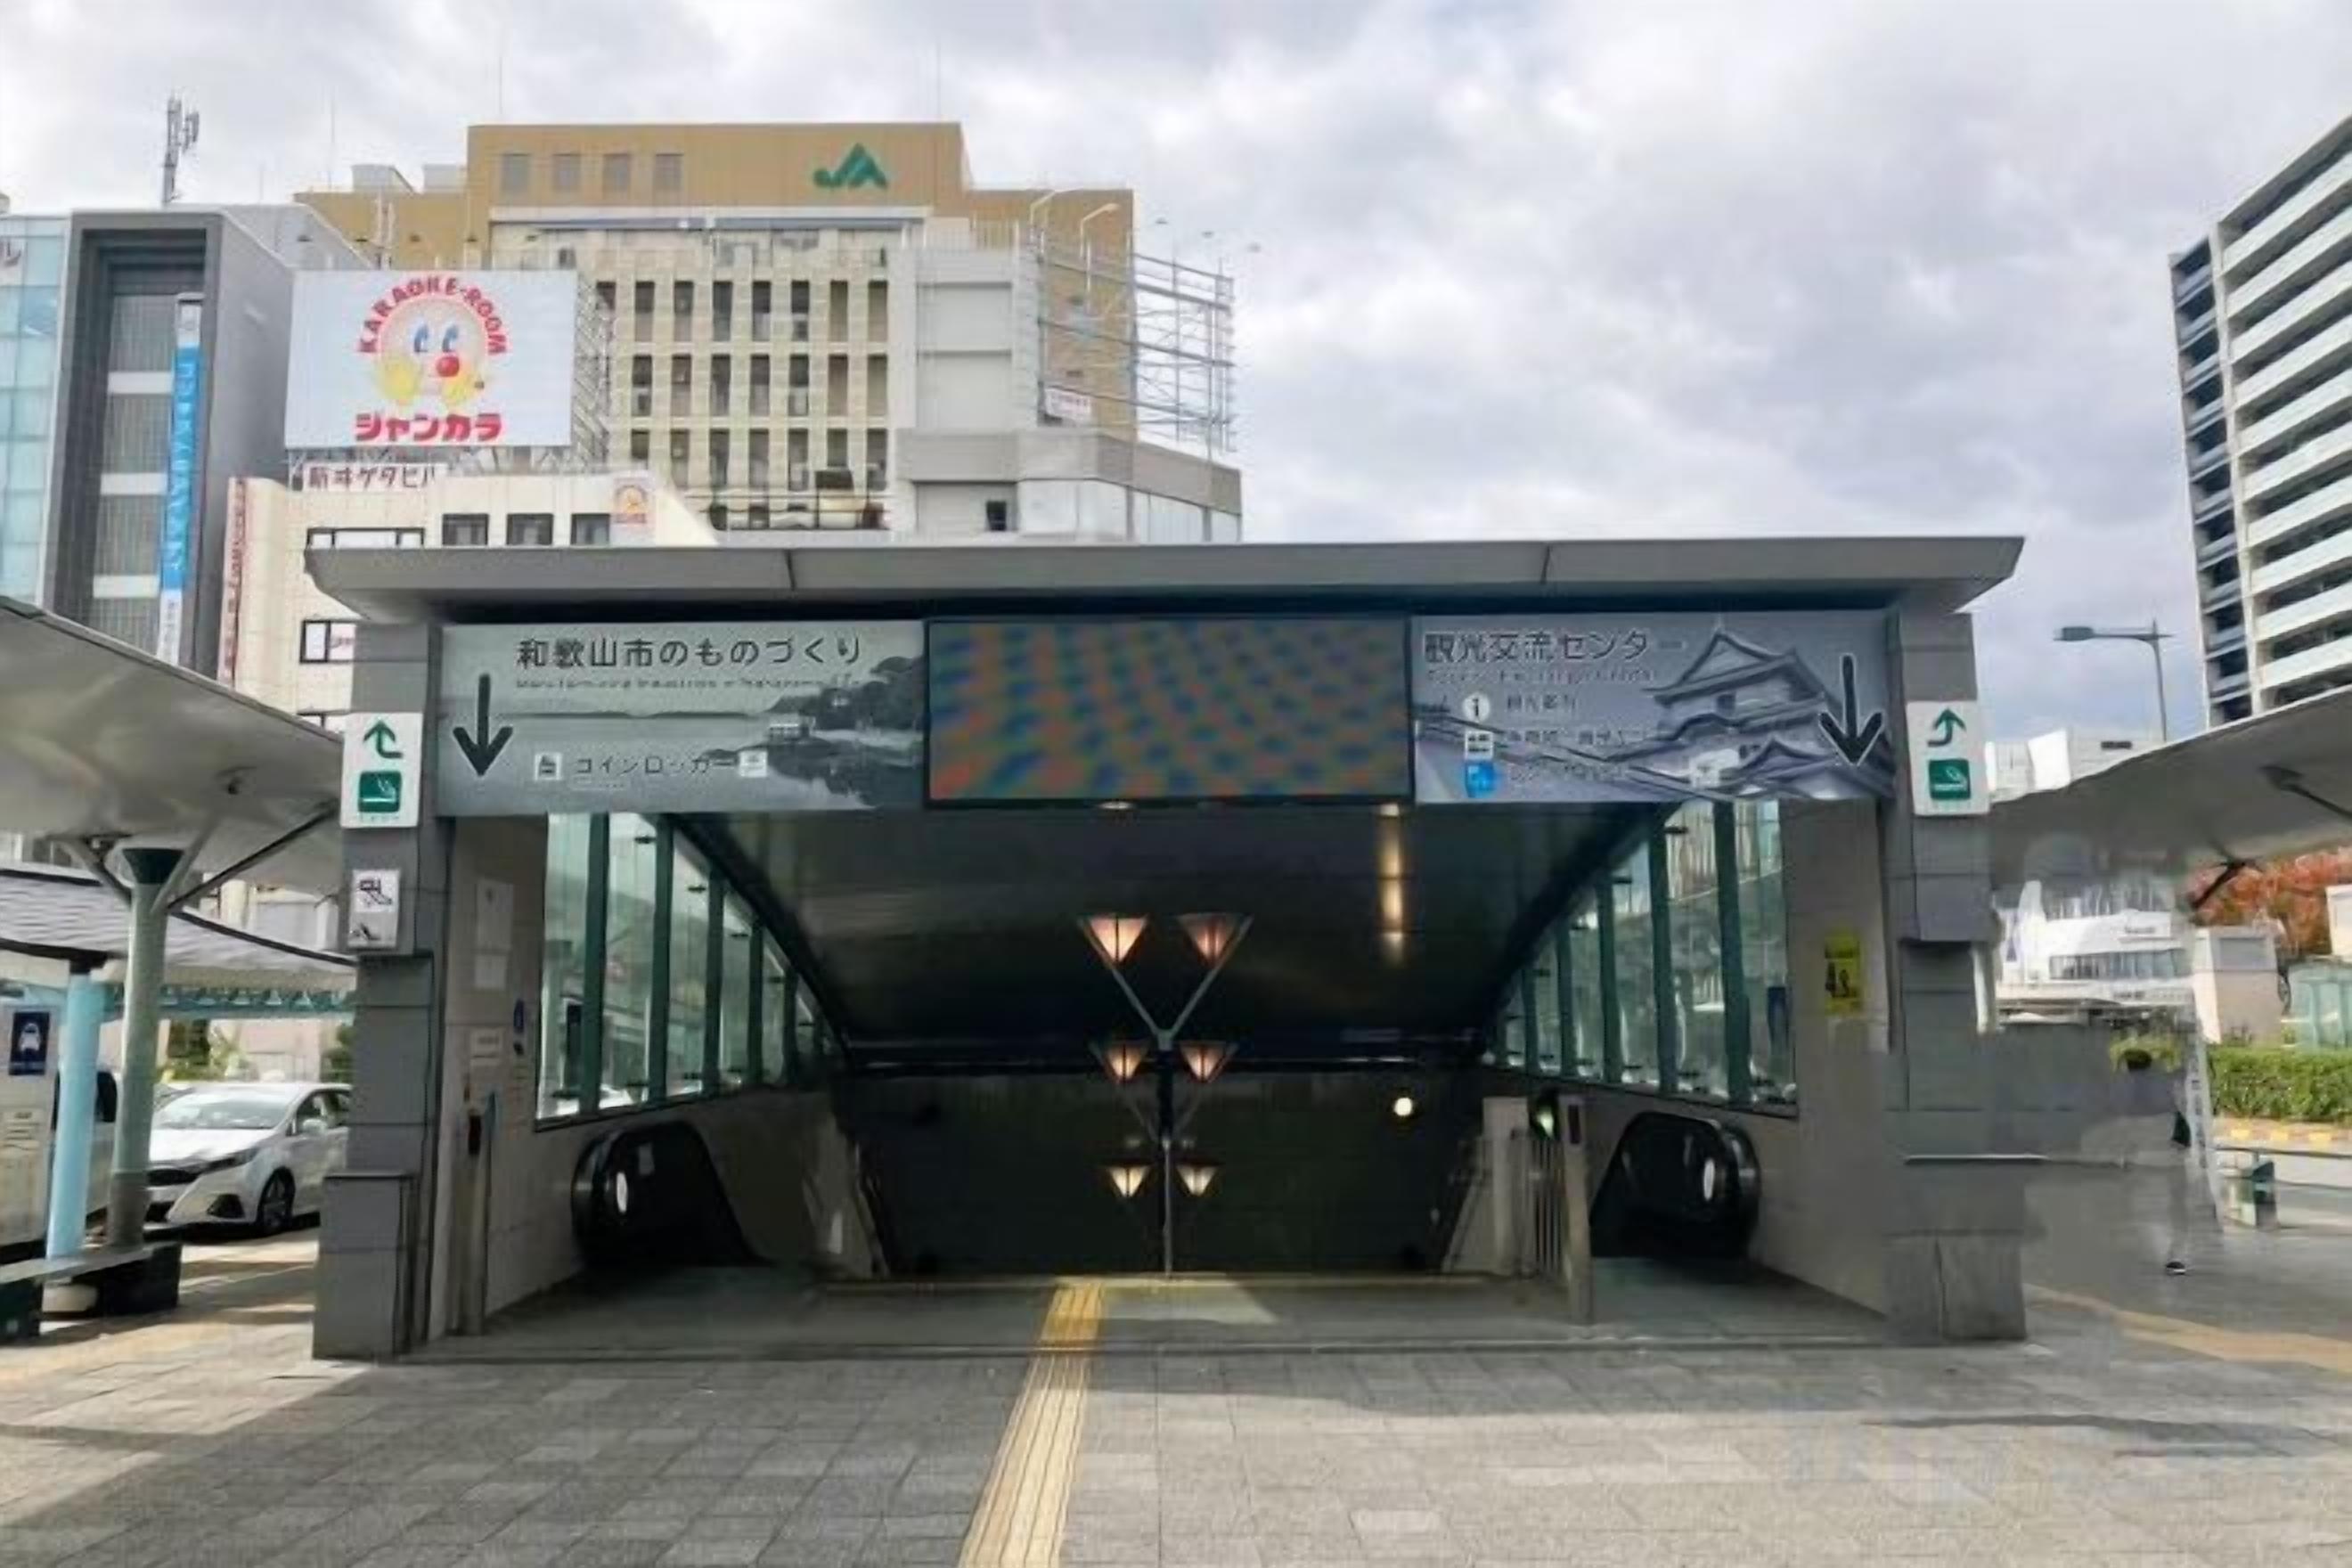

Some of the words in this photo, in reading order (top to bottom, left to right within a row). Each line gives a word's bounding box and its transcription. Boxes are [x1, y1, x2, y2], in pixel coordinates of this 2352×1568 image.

[813, 142, 888, 189] JA
[355, 412, 502, 443] ジャンカラ
[517, 636, 861, 670] 和歌山市のものづくり
[576, 756, 738, 774] コインロッカー
